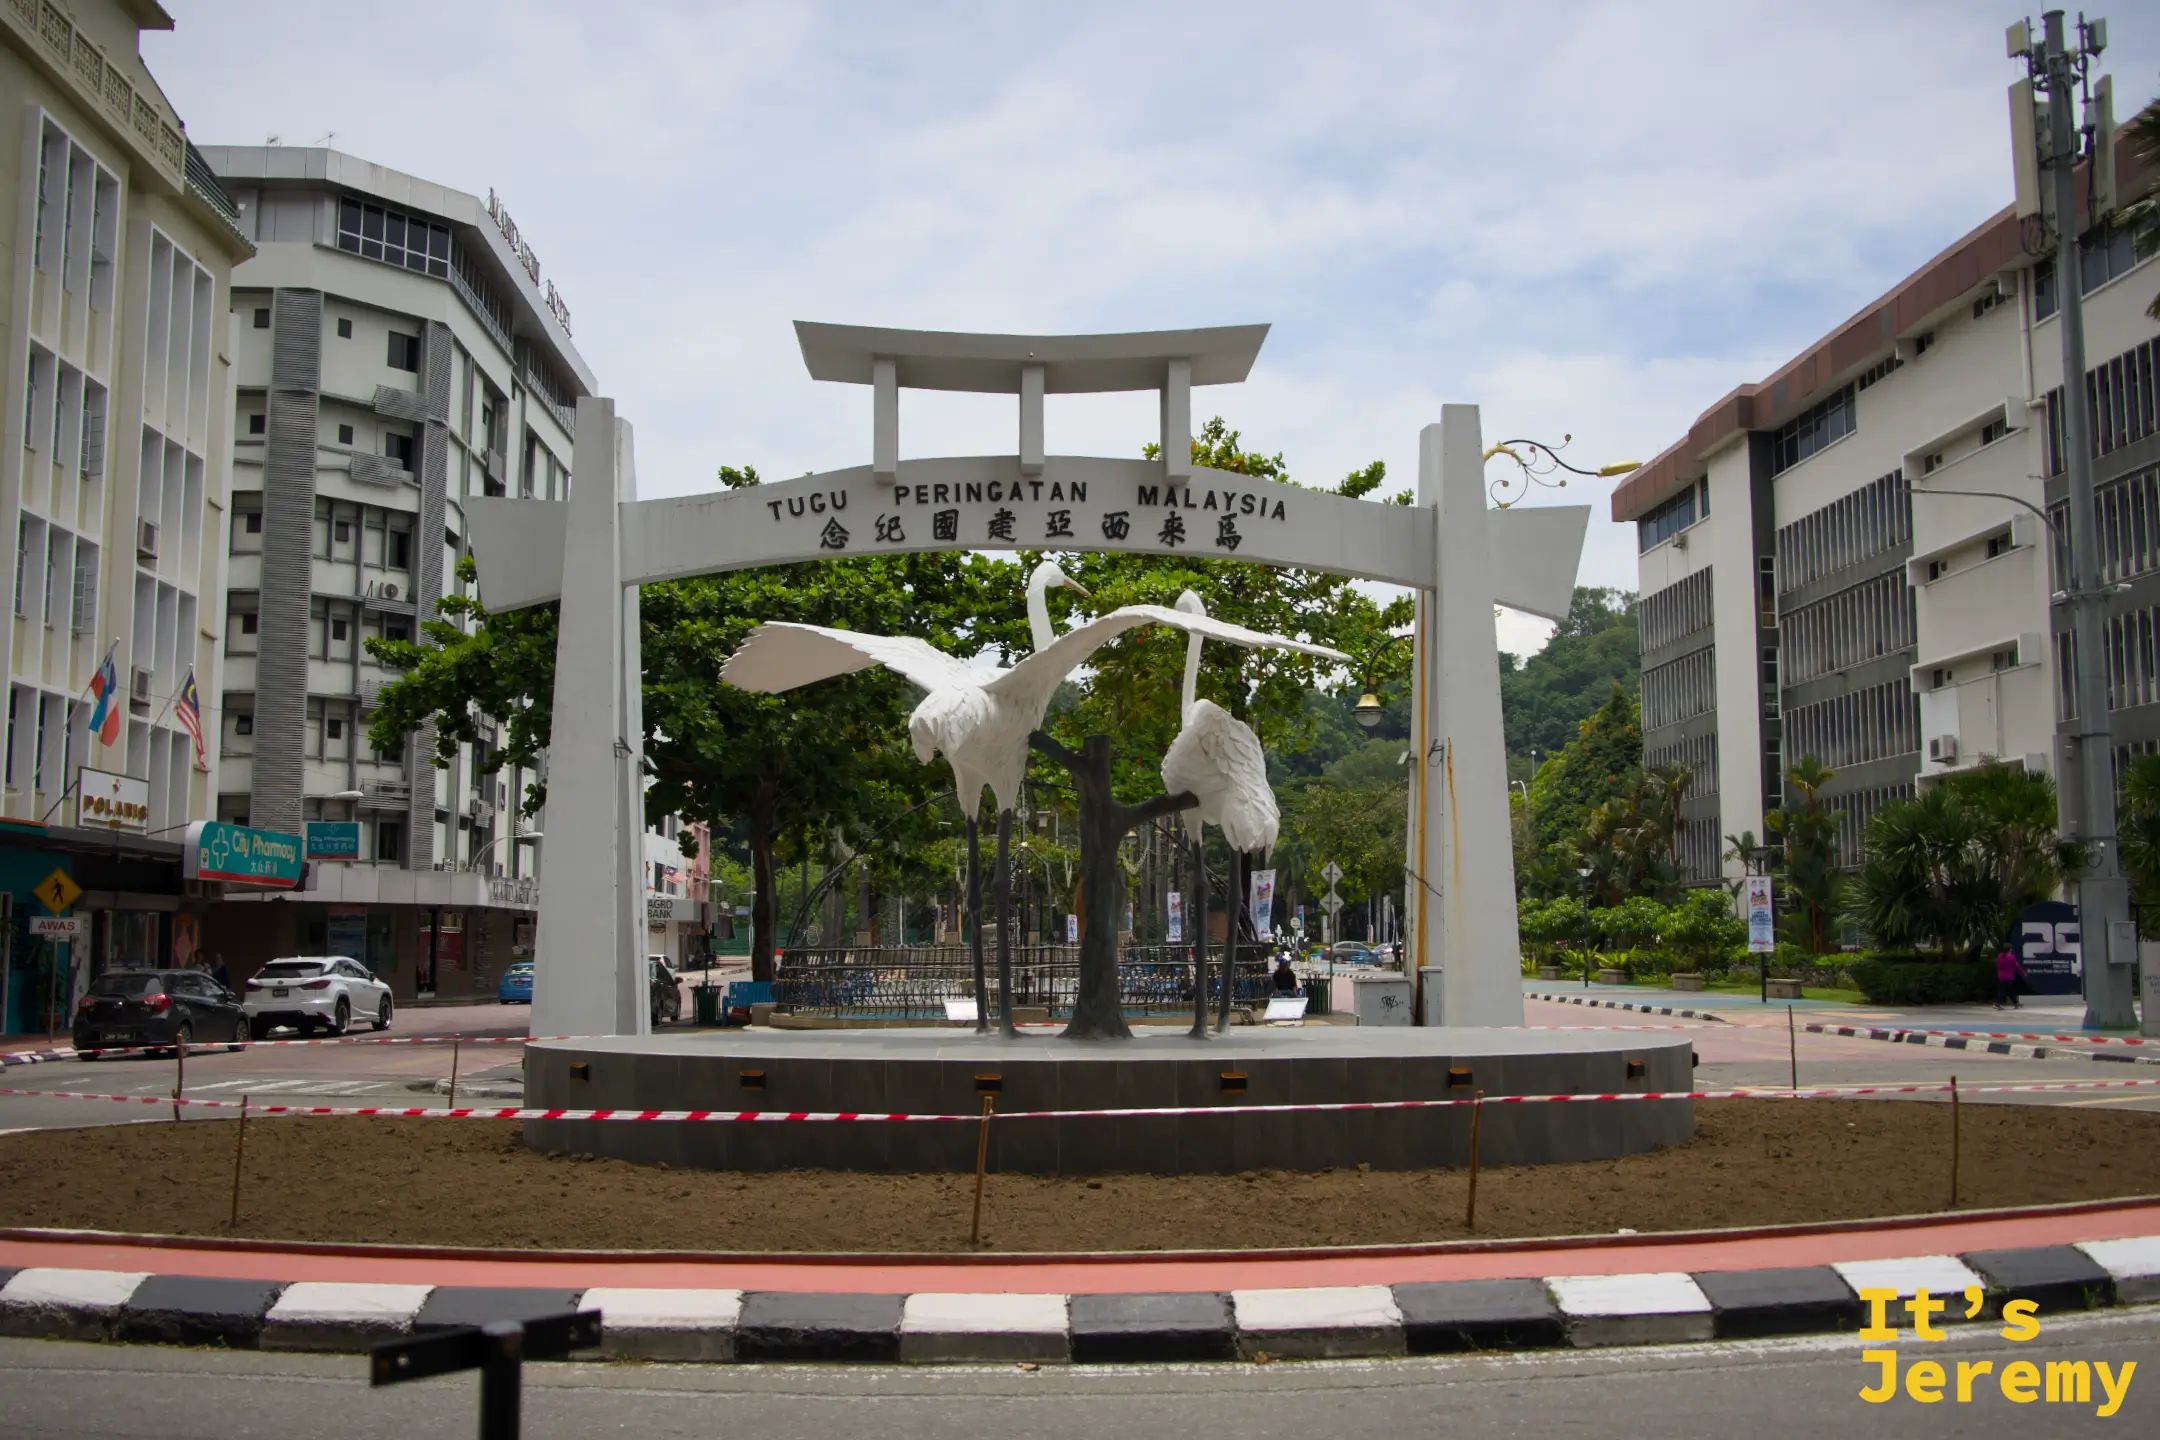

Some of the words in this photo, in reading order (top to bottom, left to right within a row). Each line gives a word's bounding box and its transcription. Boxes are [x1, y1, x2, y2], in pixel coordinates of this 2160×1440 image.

[767, 489, 848, 522] TUGU
[895, 481, 1087, 506] PERINGATAN
[1138, 484, 1286, 521] MALAYSIA
[232, 830, 250, 859] City
[252, 833, 297, 865] Pharmacy
[647, 899, 673, 909] AGRO
[647, 909, 673, 919] BANK
[38, 919, 76, 931] AWAS
